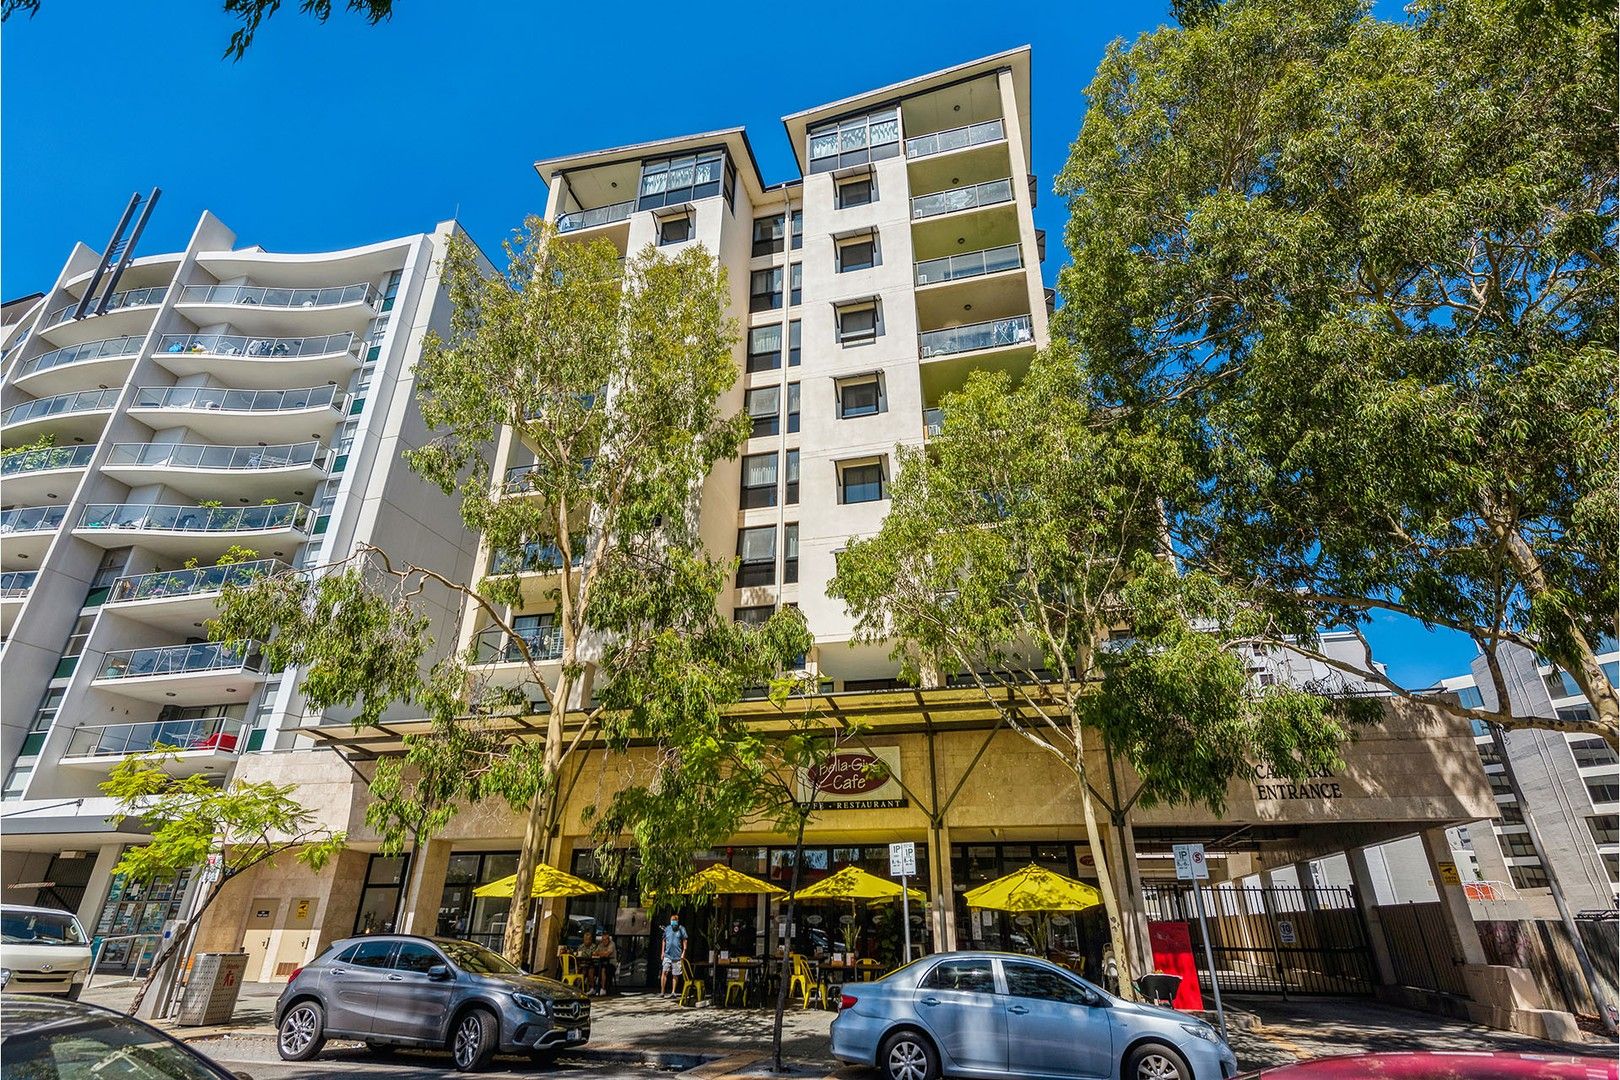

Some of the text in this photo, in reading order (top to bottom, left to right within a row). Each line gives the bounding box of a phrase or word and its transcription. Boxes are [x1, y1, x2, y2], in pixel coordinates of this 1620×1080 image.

[833, 774, 866, 790] Cafe
[1256, 783, 1342, 800] ENTRANCE
[836, 800, 900, 808] RESTAURANT
